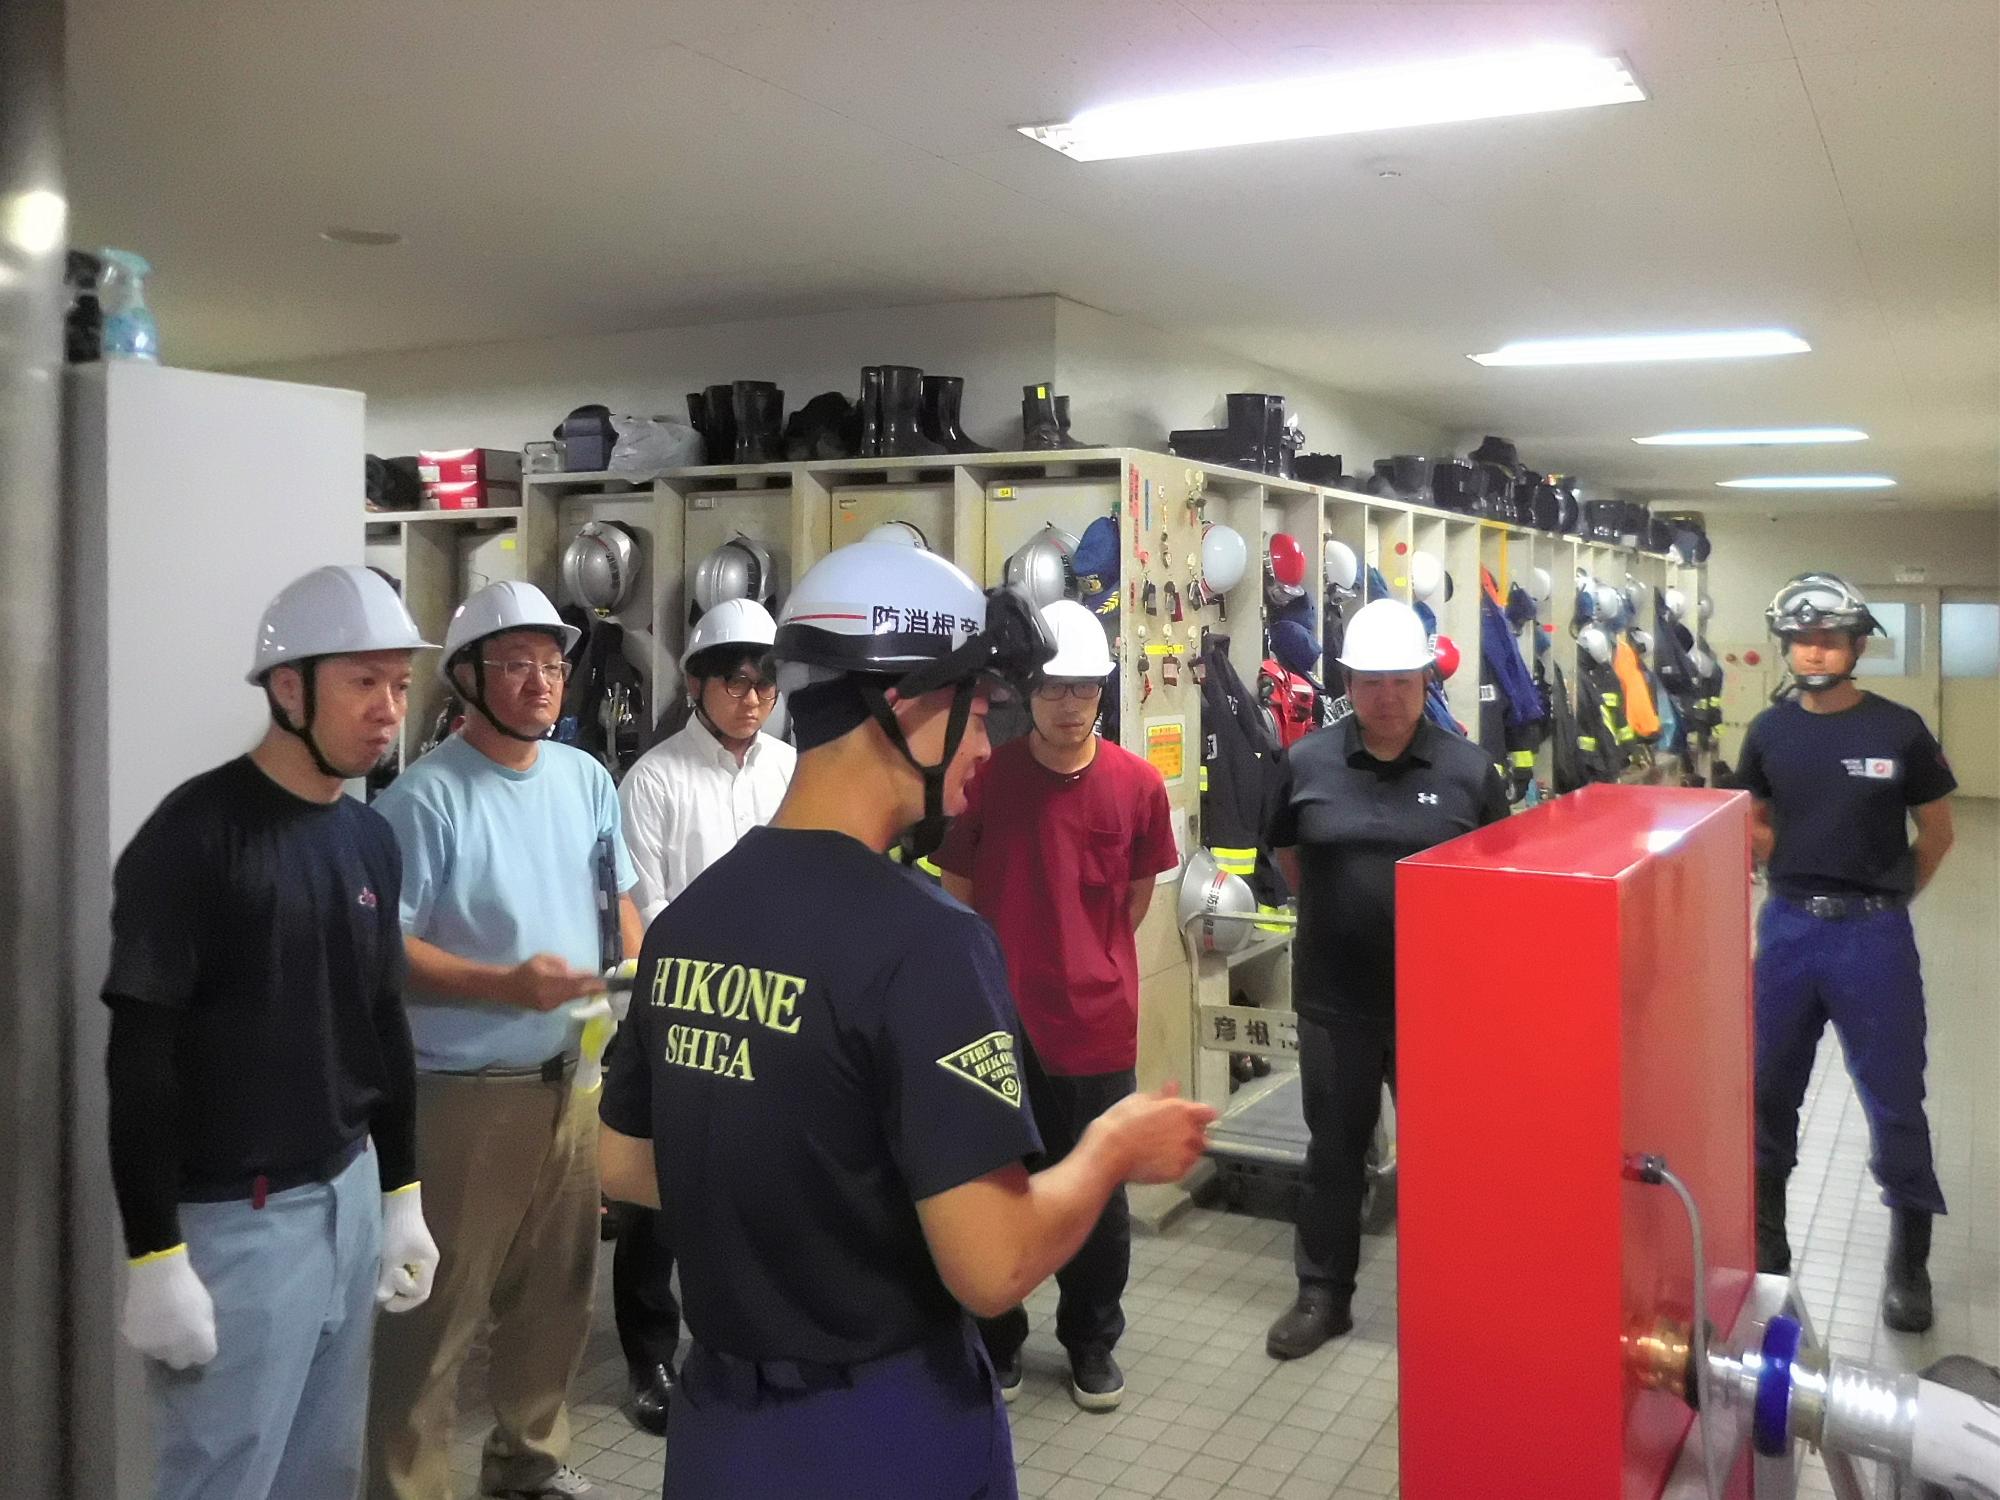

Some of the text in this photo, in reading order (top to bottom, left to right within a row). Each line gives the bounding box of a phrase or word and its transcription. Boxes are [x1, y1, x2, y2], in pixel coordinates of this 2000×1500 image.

[651, 957, 807, 1034] HIKONE
[665, 1024, 755, 1081] SHIGA
[960, 1041, 993, 1068] FIRE
